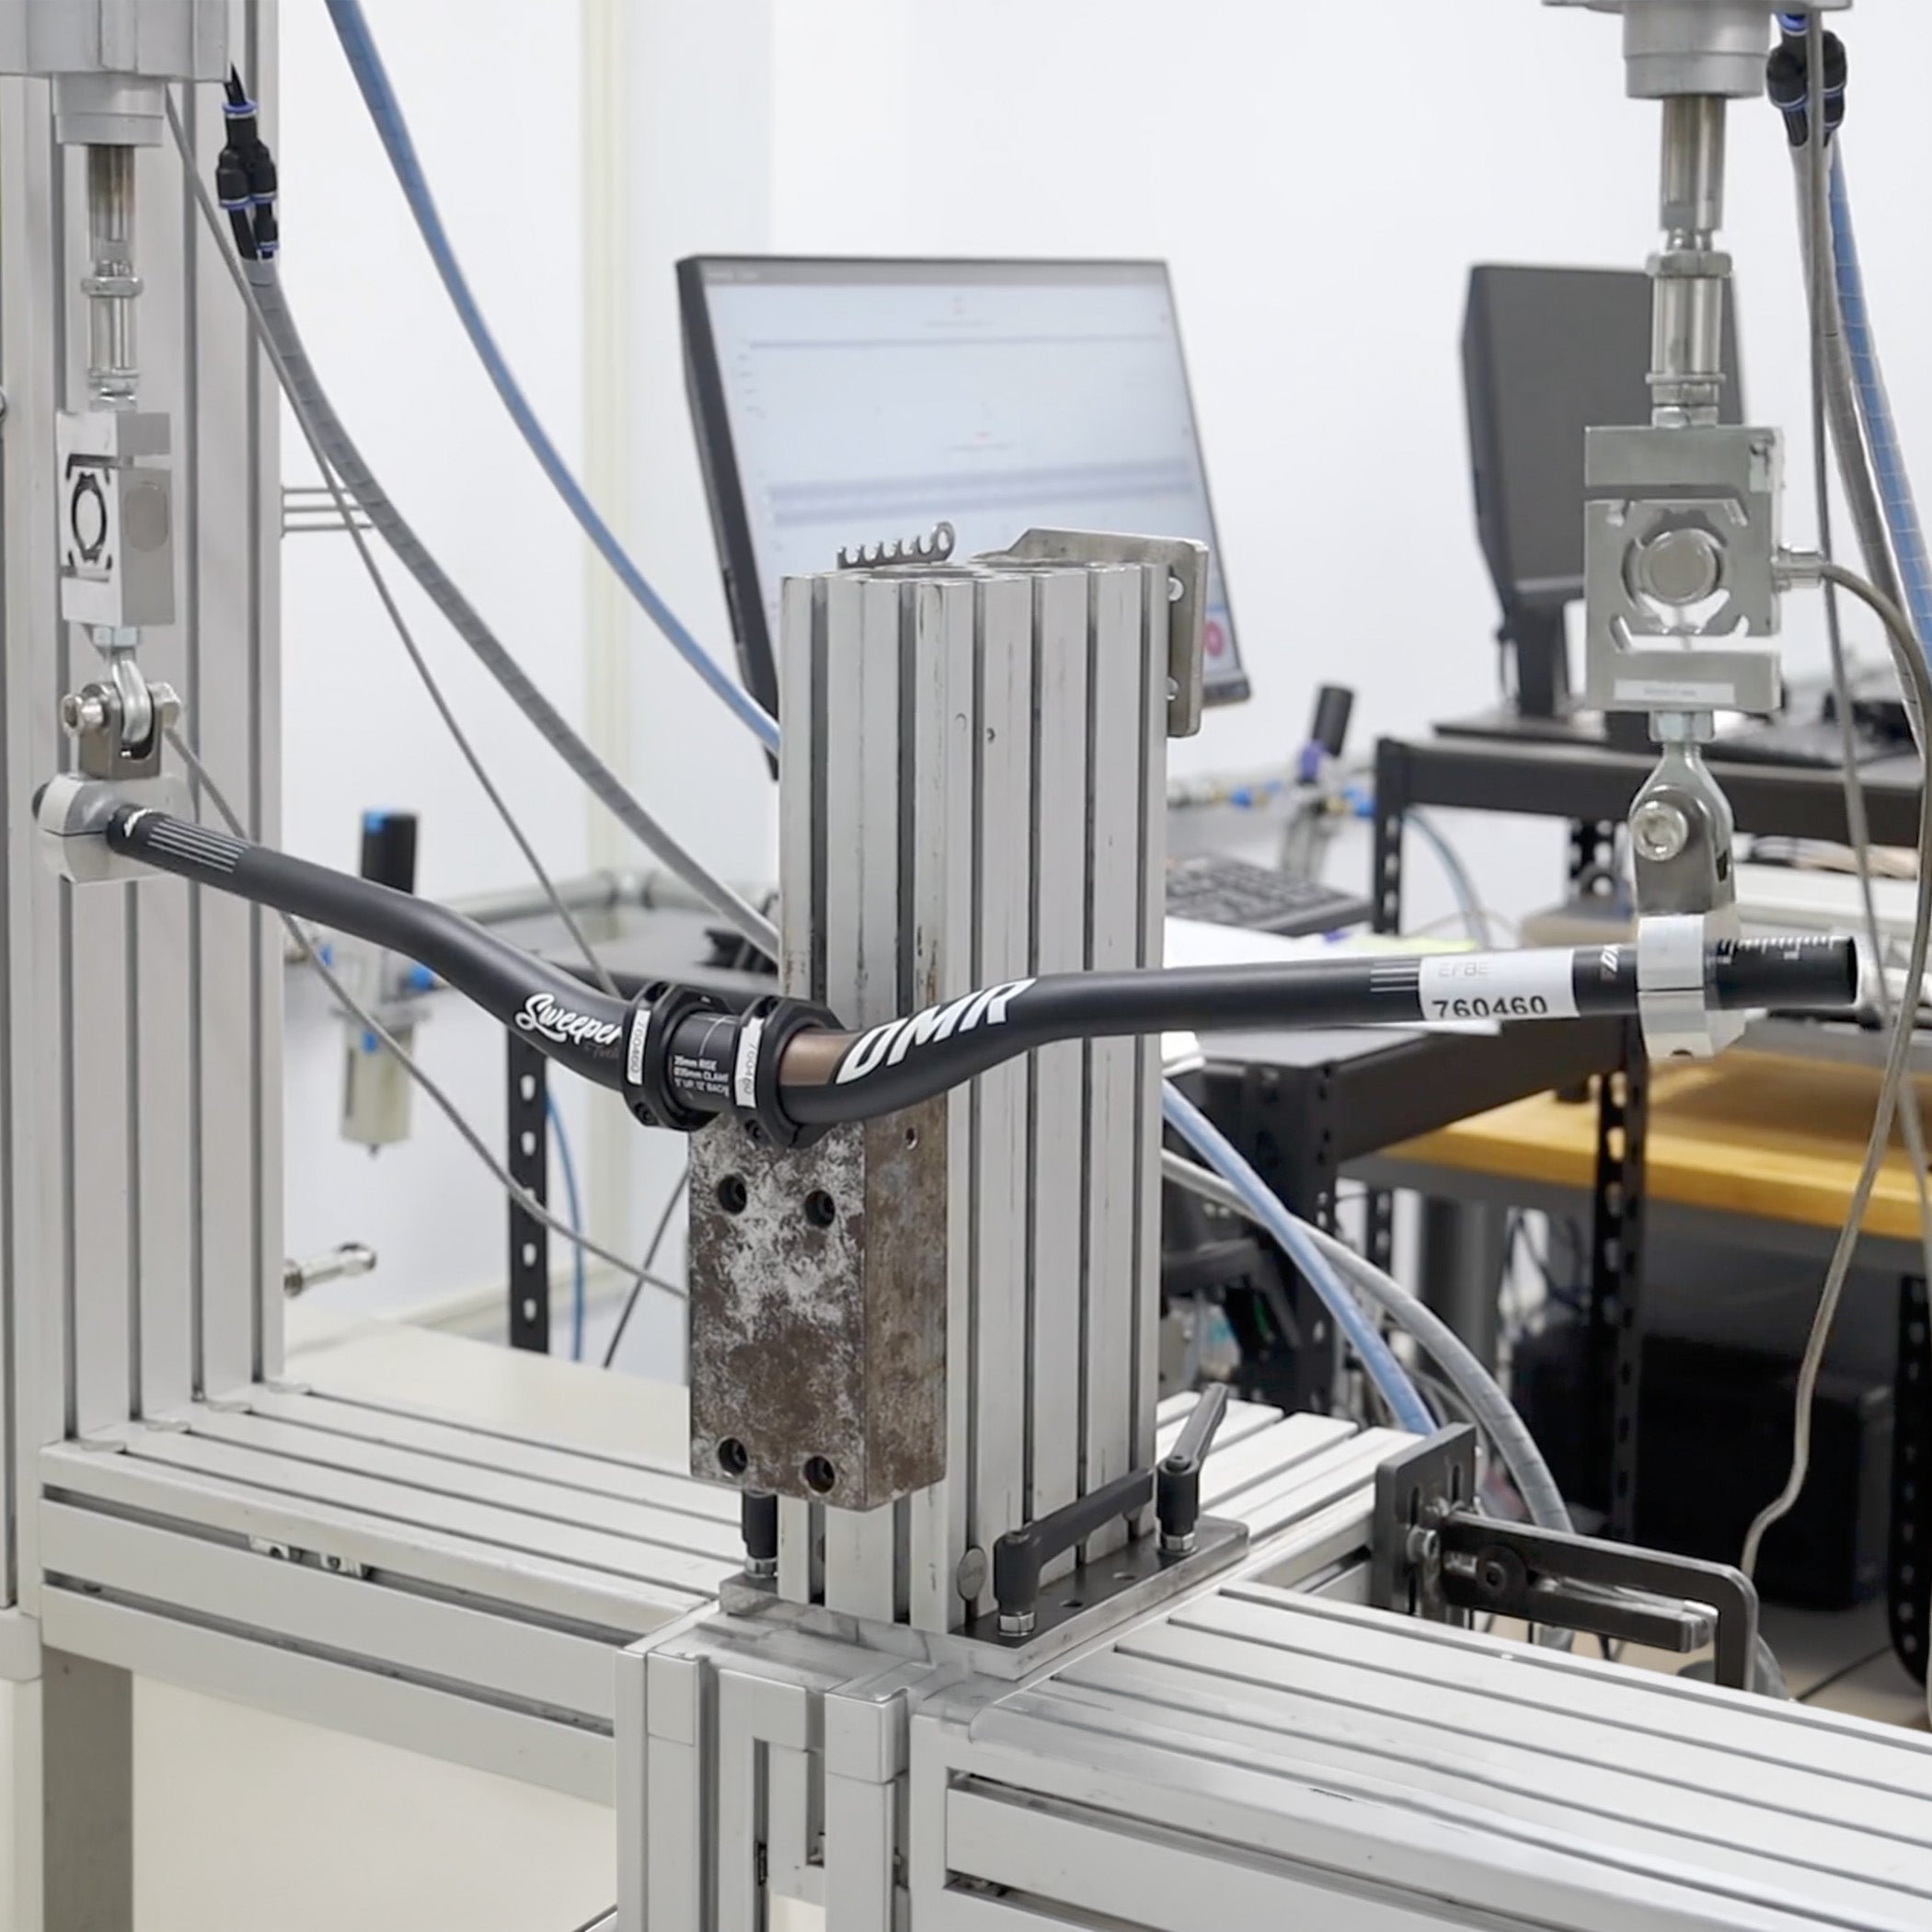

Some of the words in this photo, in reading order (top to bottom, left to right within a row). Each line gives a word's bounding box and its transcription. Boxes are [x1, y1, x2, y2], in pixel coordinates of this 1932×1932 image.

[515, 993, 623, 1045] Sweeper
[835, 978, 1037, 1085] DMR
[1432, 995, 1548, 1018] 760460
